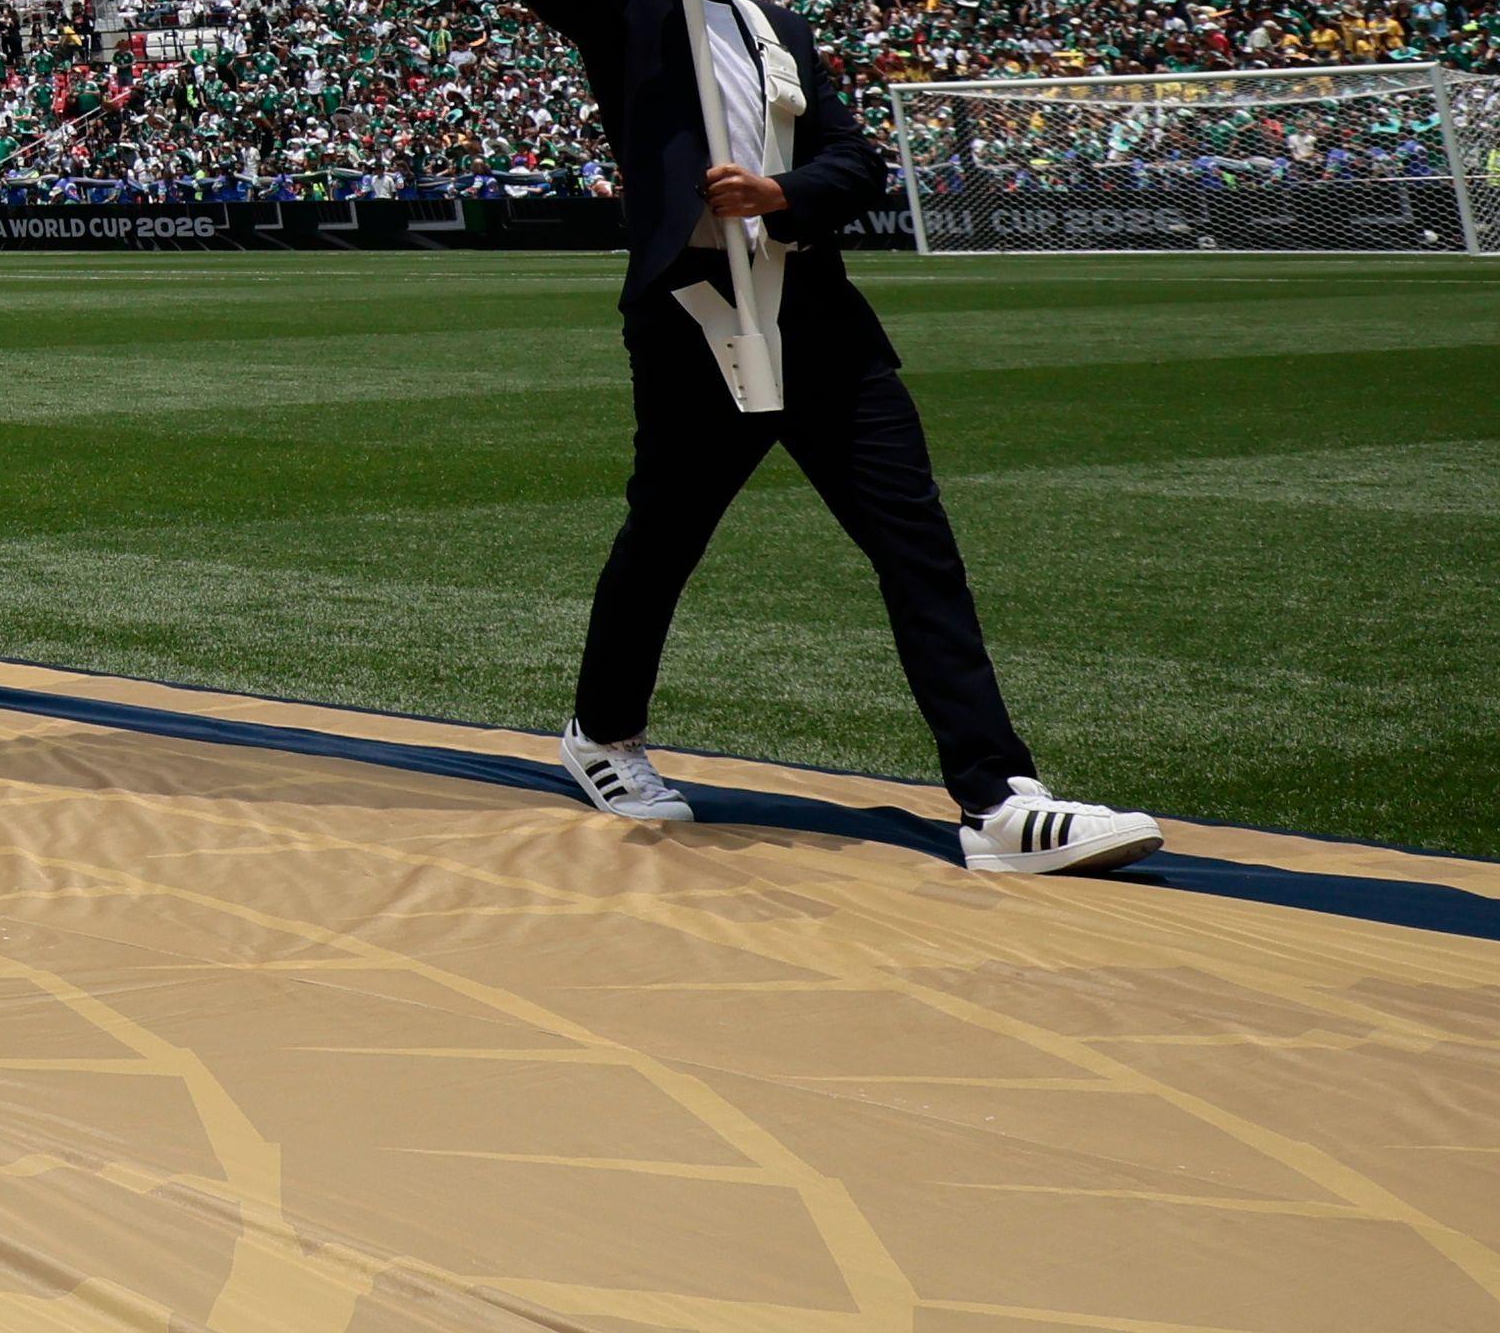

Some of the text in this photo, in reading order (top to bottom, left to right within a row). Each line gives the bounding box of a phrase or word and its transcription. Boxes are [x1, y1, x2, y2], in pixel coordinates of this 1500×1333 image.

[9, 217, 86, 238] WORLD
[89, 217, 132, 237] CUP
[135, 217, 215, 237] 2026
